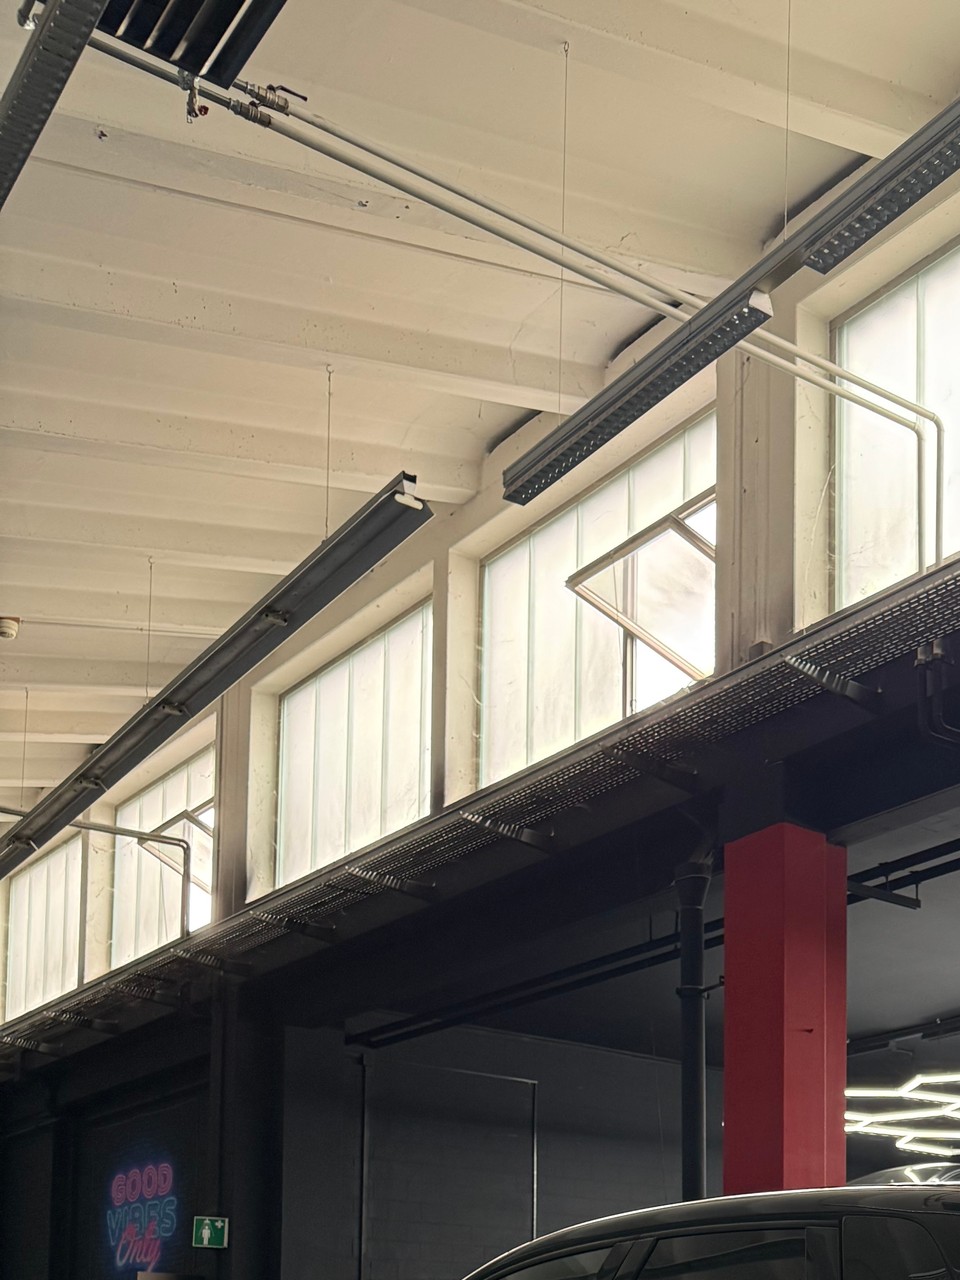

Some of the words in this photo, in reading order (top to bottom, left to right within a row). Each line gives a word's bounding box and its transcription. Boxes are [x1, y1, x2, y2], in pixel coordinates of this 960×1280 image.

[111, 1163, 173, 1206] GOOD
[106, 1196, 177, 1246] VIBES
[116, 1219, 161, 1272] Only
